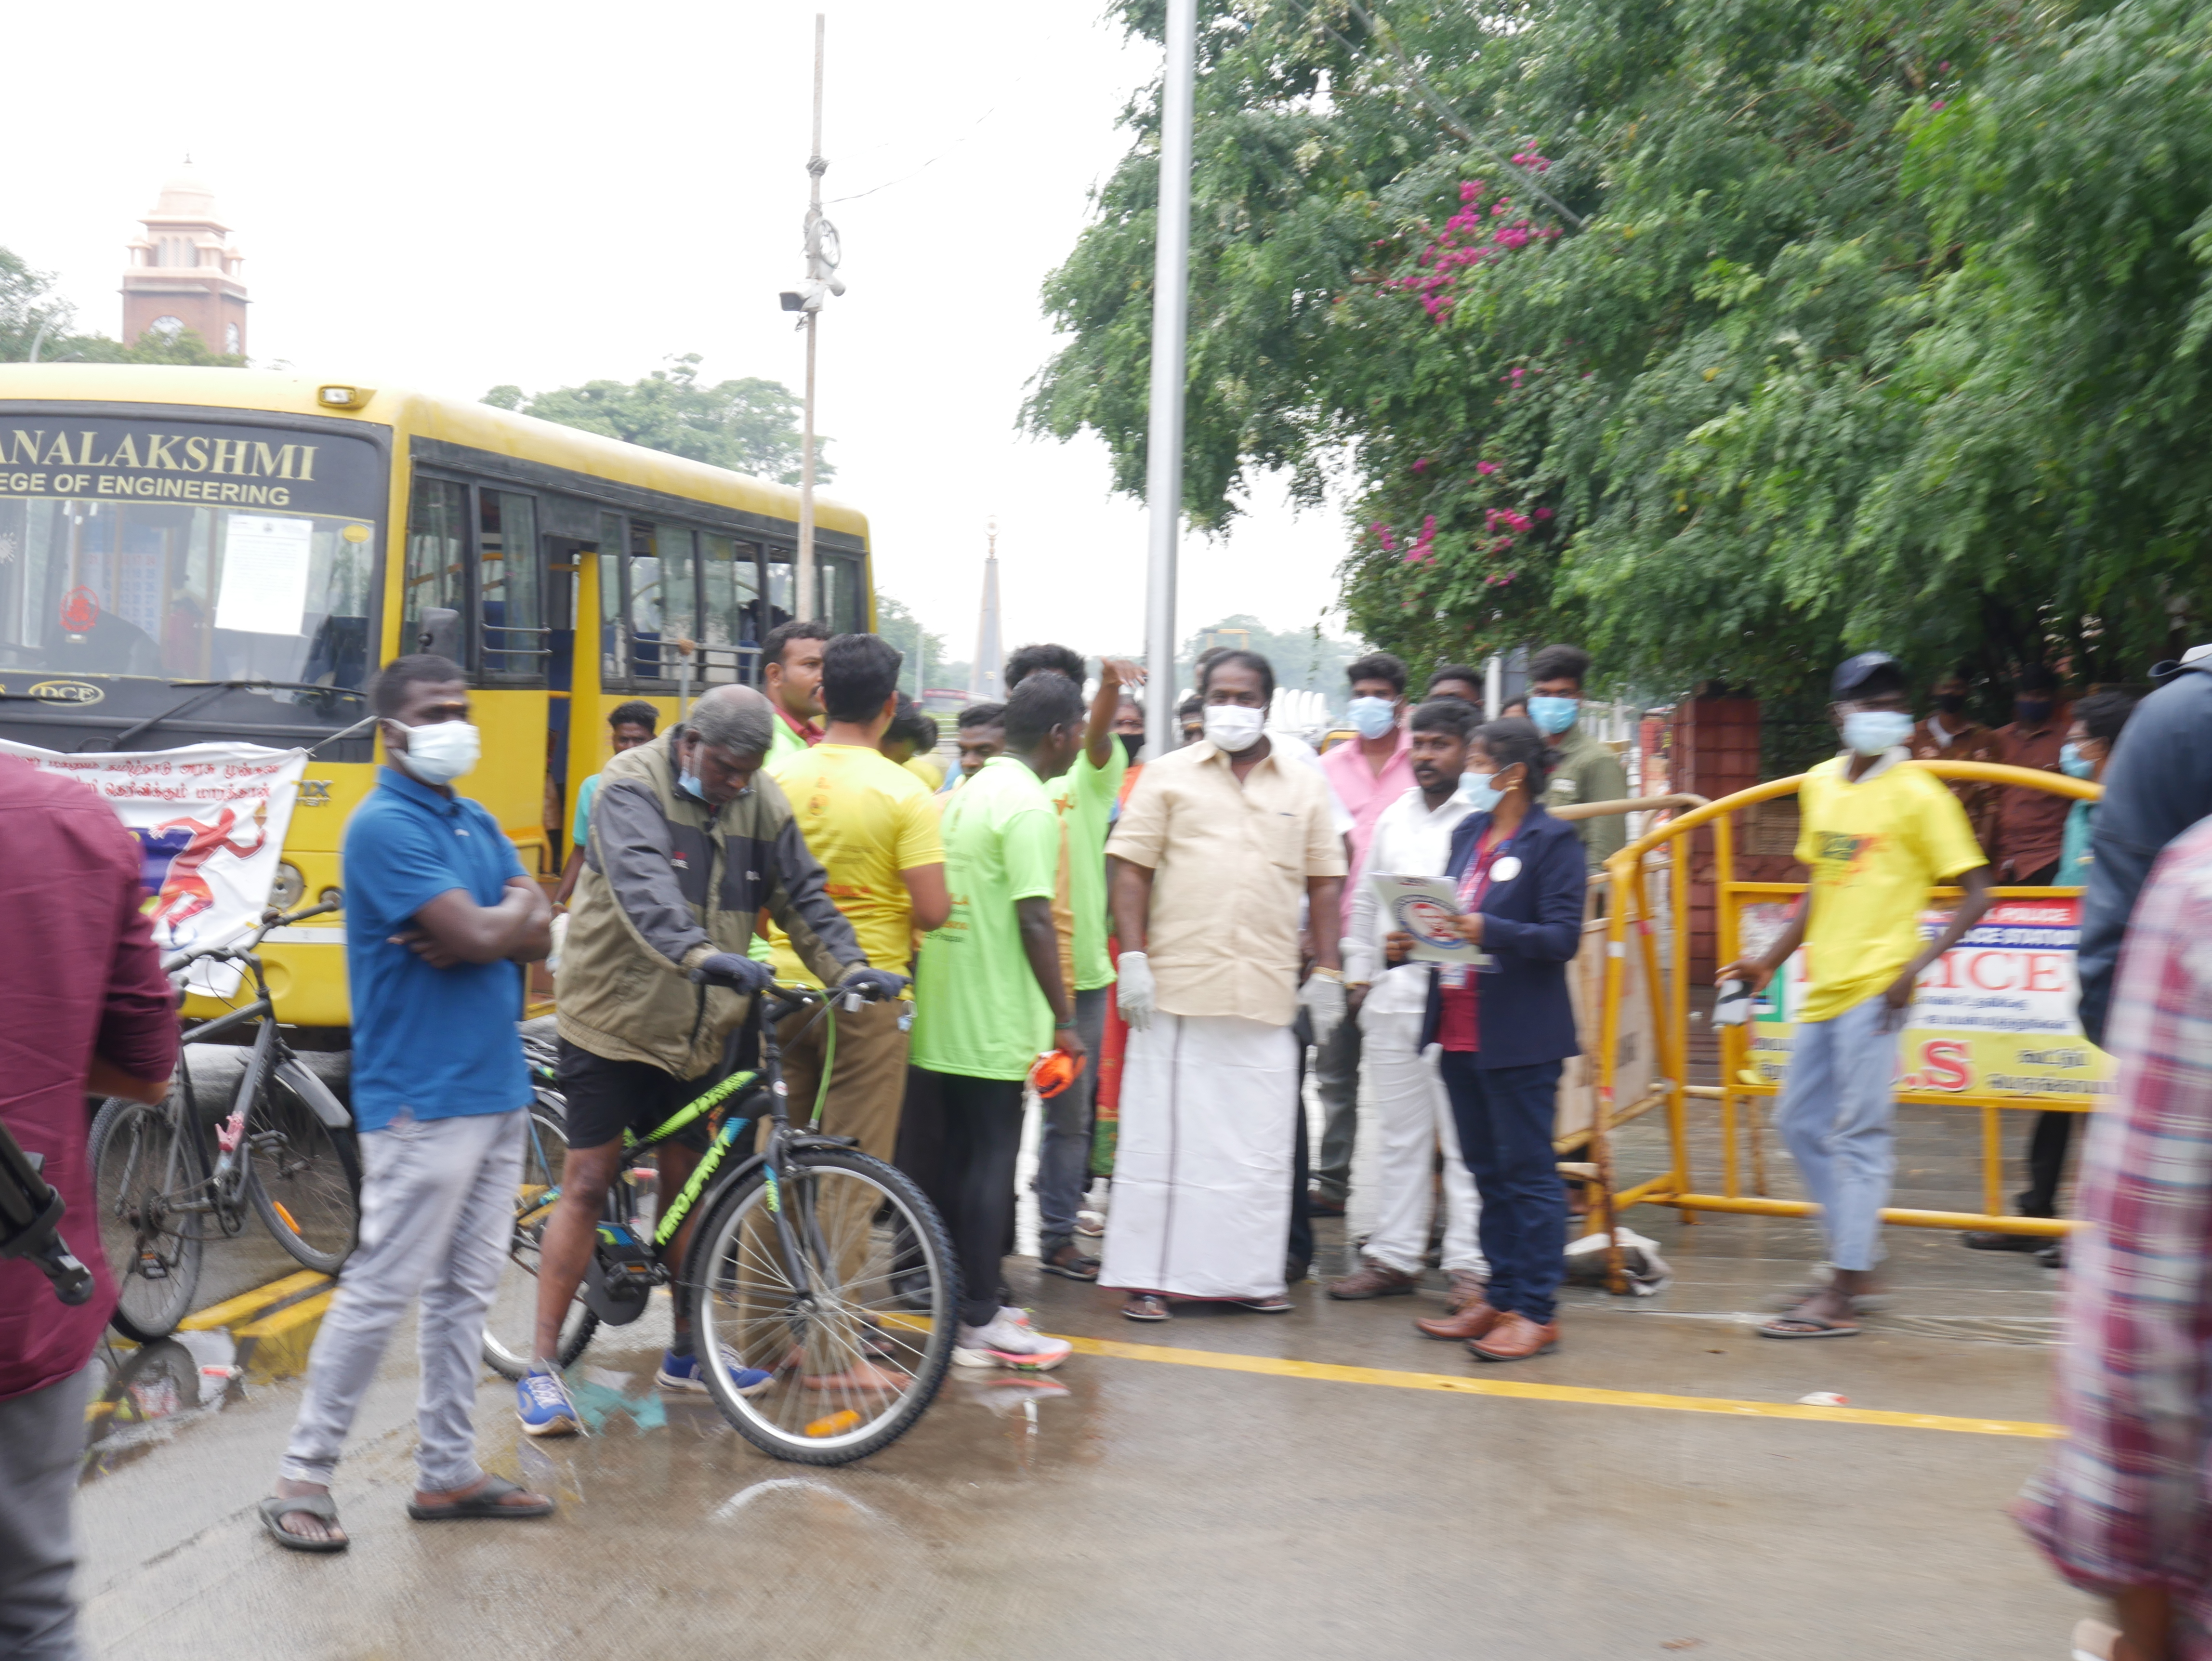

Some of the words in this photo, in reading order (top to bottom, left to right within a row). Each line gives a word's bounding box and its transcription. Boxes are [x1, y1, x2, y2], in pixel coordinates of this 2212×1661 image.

[53, 473, 92, 492] OF
[97, 475, 290, 506] ENGINEERING
[654, 1193, 691, 1246] HERO
